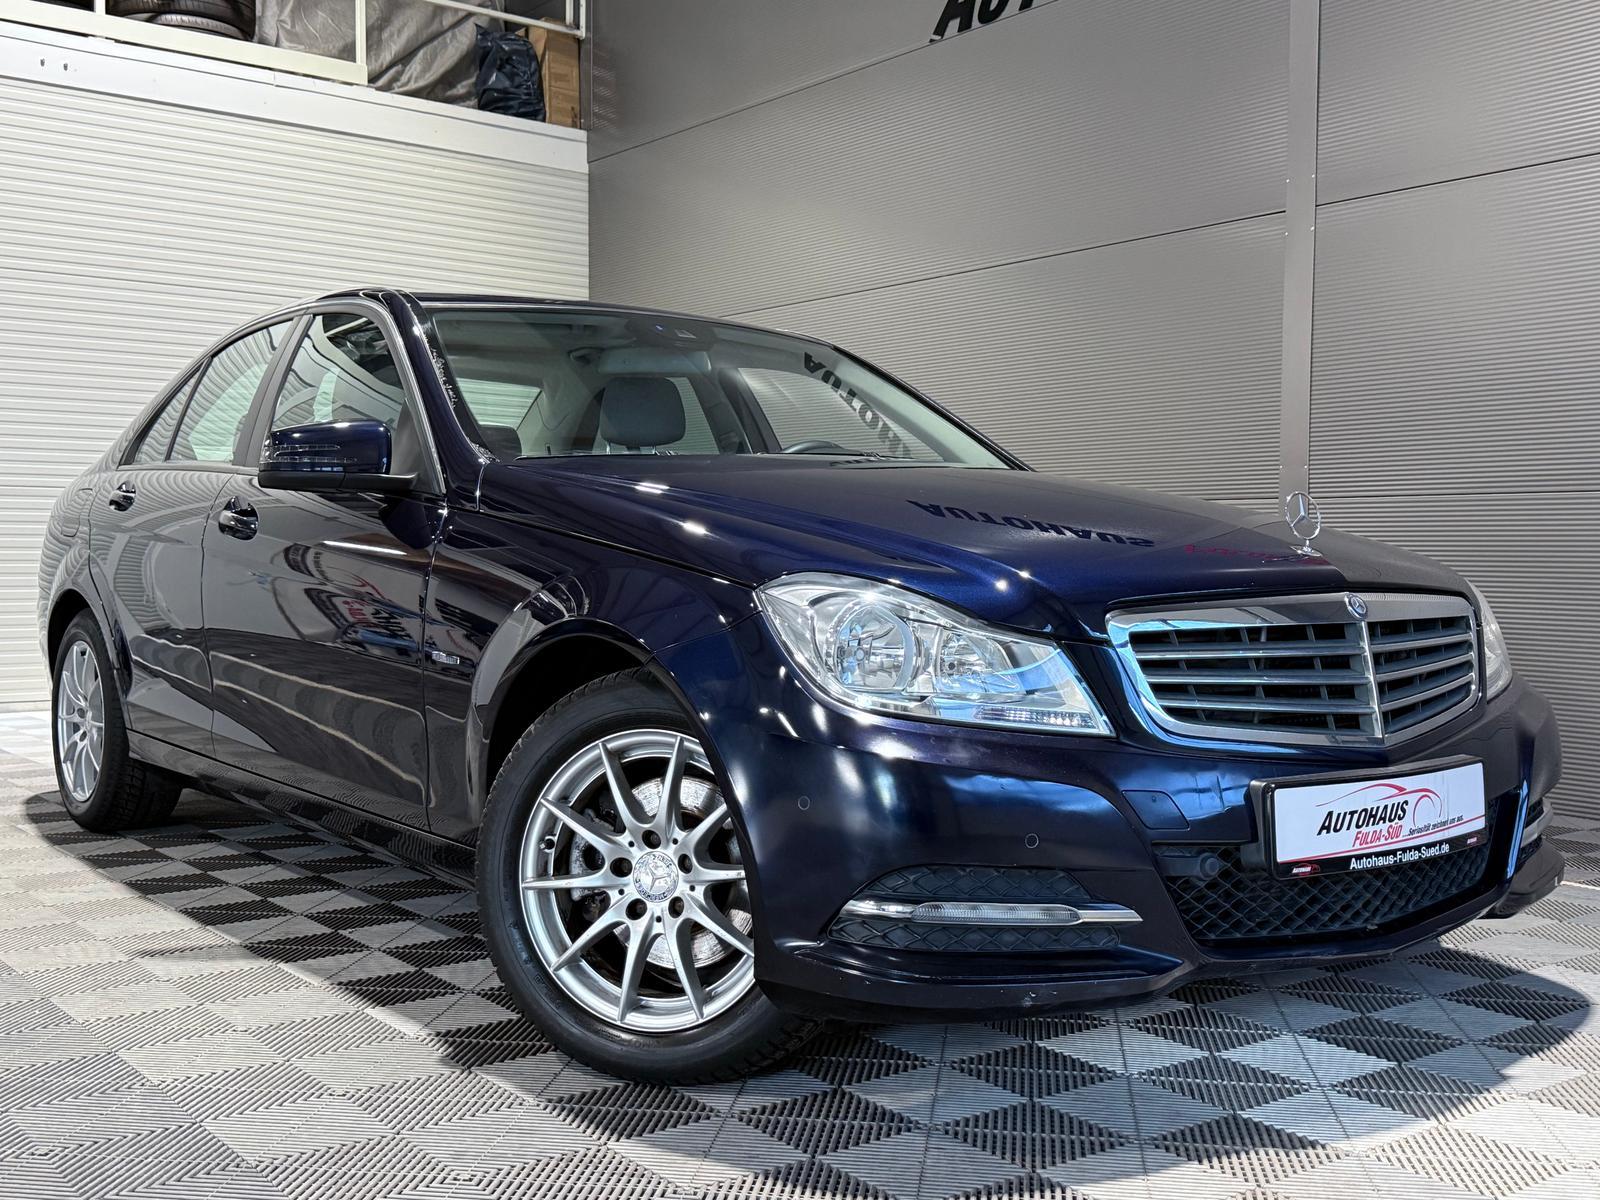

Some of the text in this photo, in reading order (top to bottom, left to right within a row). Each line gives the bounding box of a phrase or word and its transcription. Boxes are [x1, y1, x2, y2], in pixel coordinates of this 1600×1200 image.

[1317, 800, 1409, 836] AUTOHAUS
[1352, 822, 1403, 847] FULDA-SÜD
[1350, 842, 1450, 870] Autohaus-Fulda-Sued.de
